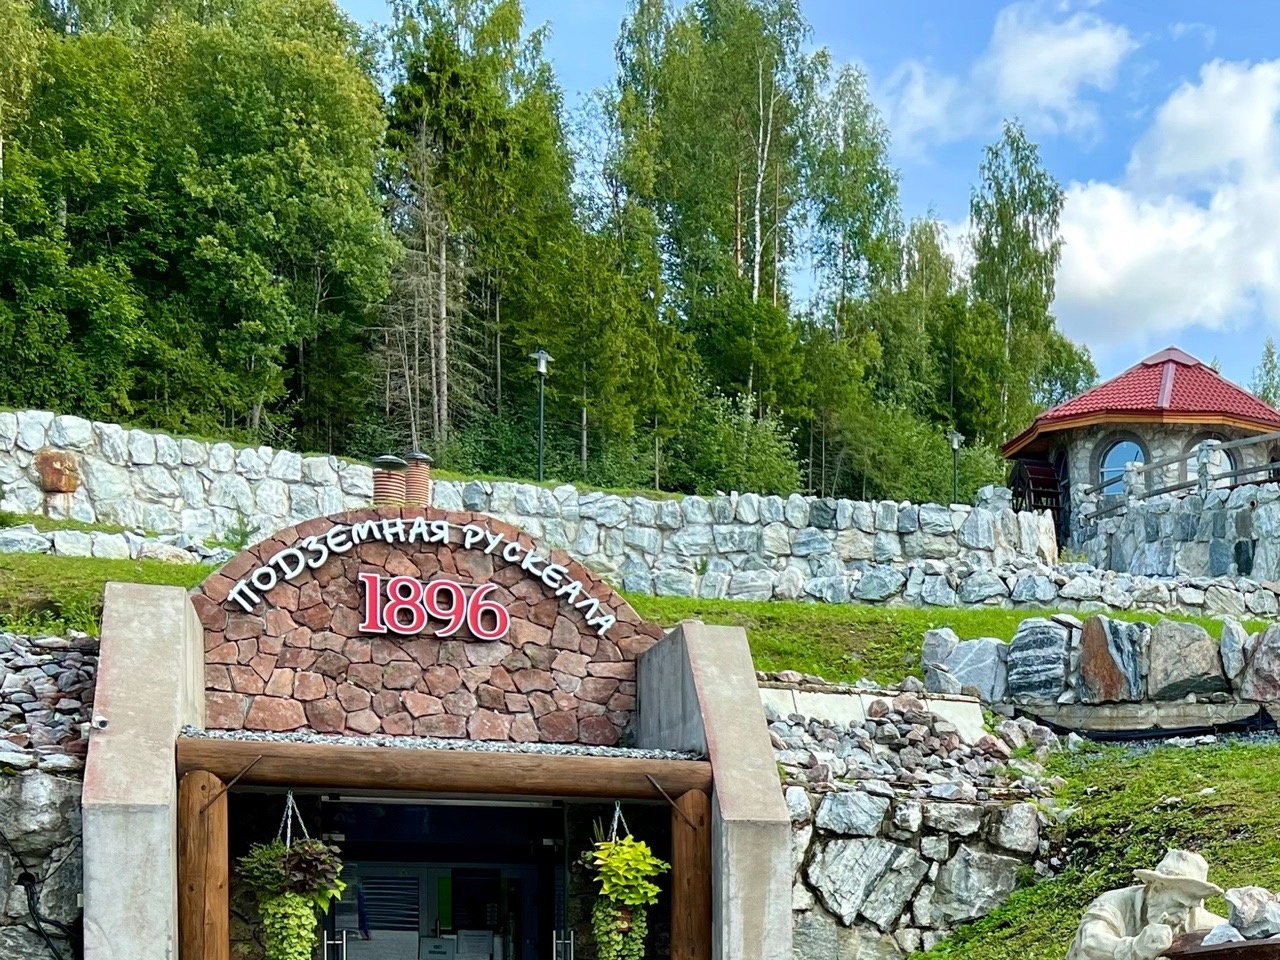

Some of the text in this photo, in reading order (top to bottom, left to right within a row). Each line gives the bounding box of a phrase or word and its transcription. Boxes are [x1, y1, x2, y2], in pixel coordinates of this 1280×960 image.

[227, 517, 616, 635] ПОДЗЕМНАЯ РУСКЕАЛА
[358, 573, 510, 641] 1896
